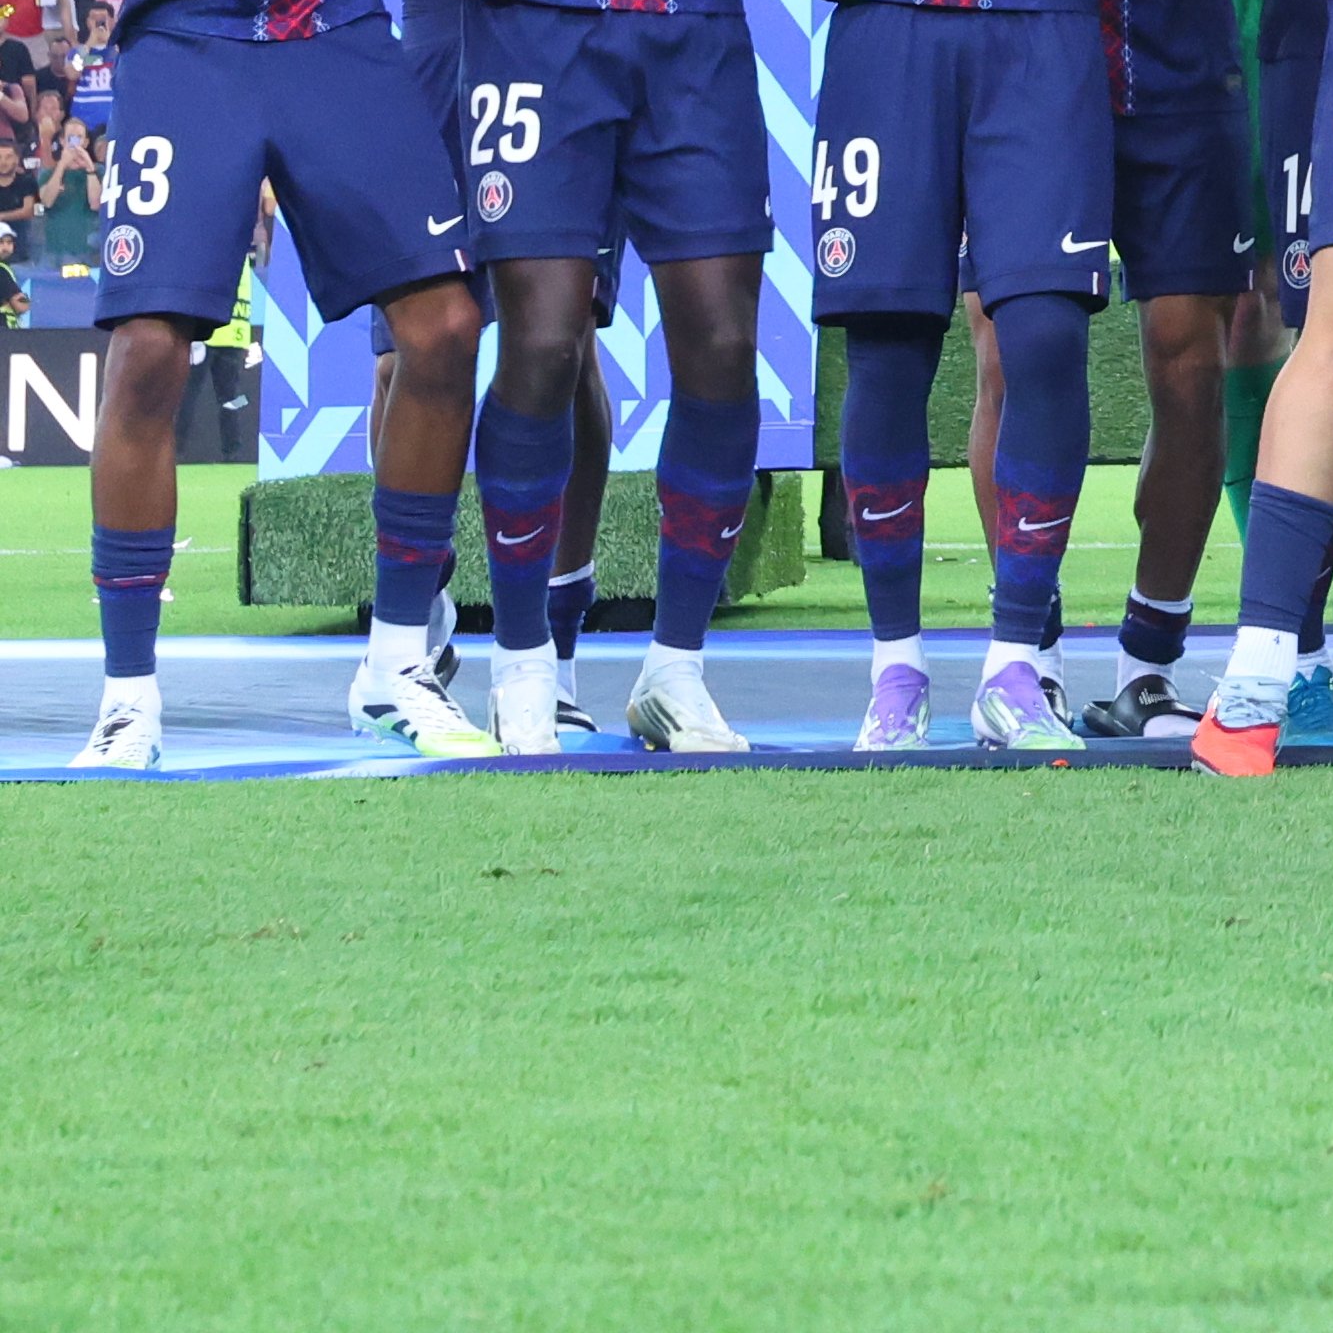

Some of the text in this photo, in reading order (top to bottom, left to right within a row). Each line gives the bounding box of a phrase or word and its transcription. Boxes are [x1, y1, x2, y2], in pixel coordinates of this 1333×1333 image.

[469, 82, 543, 165] 25
[100, 135, 174, 219] 43
[810, 136, 882, 220] 49
